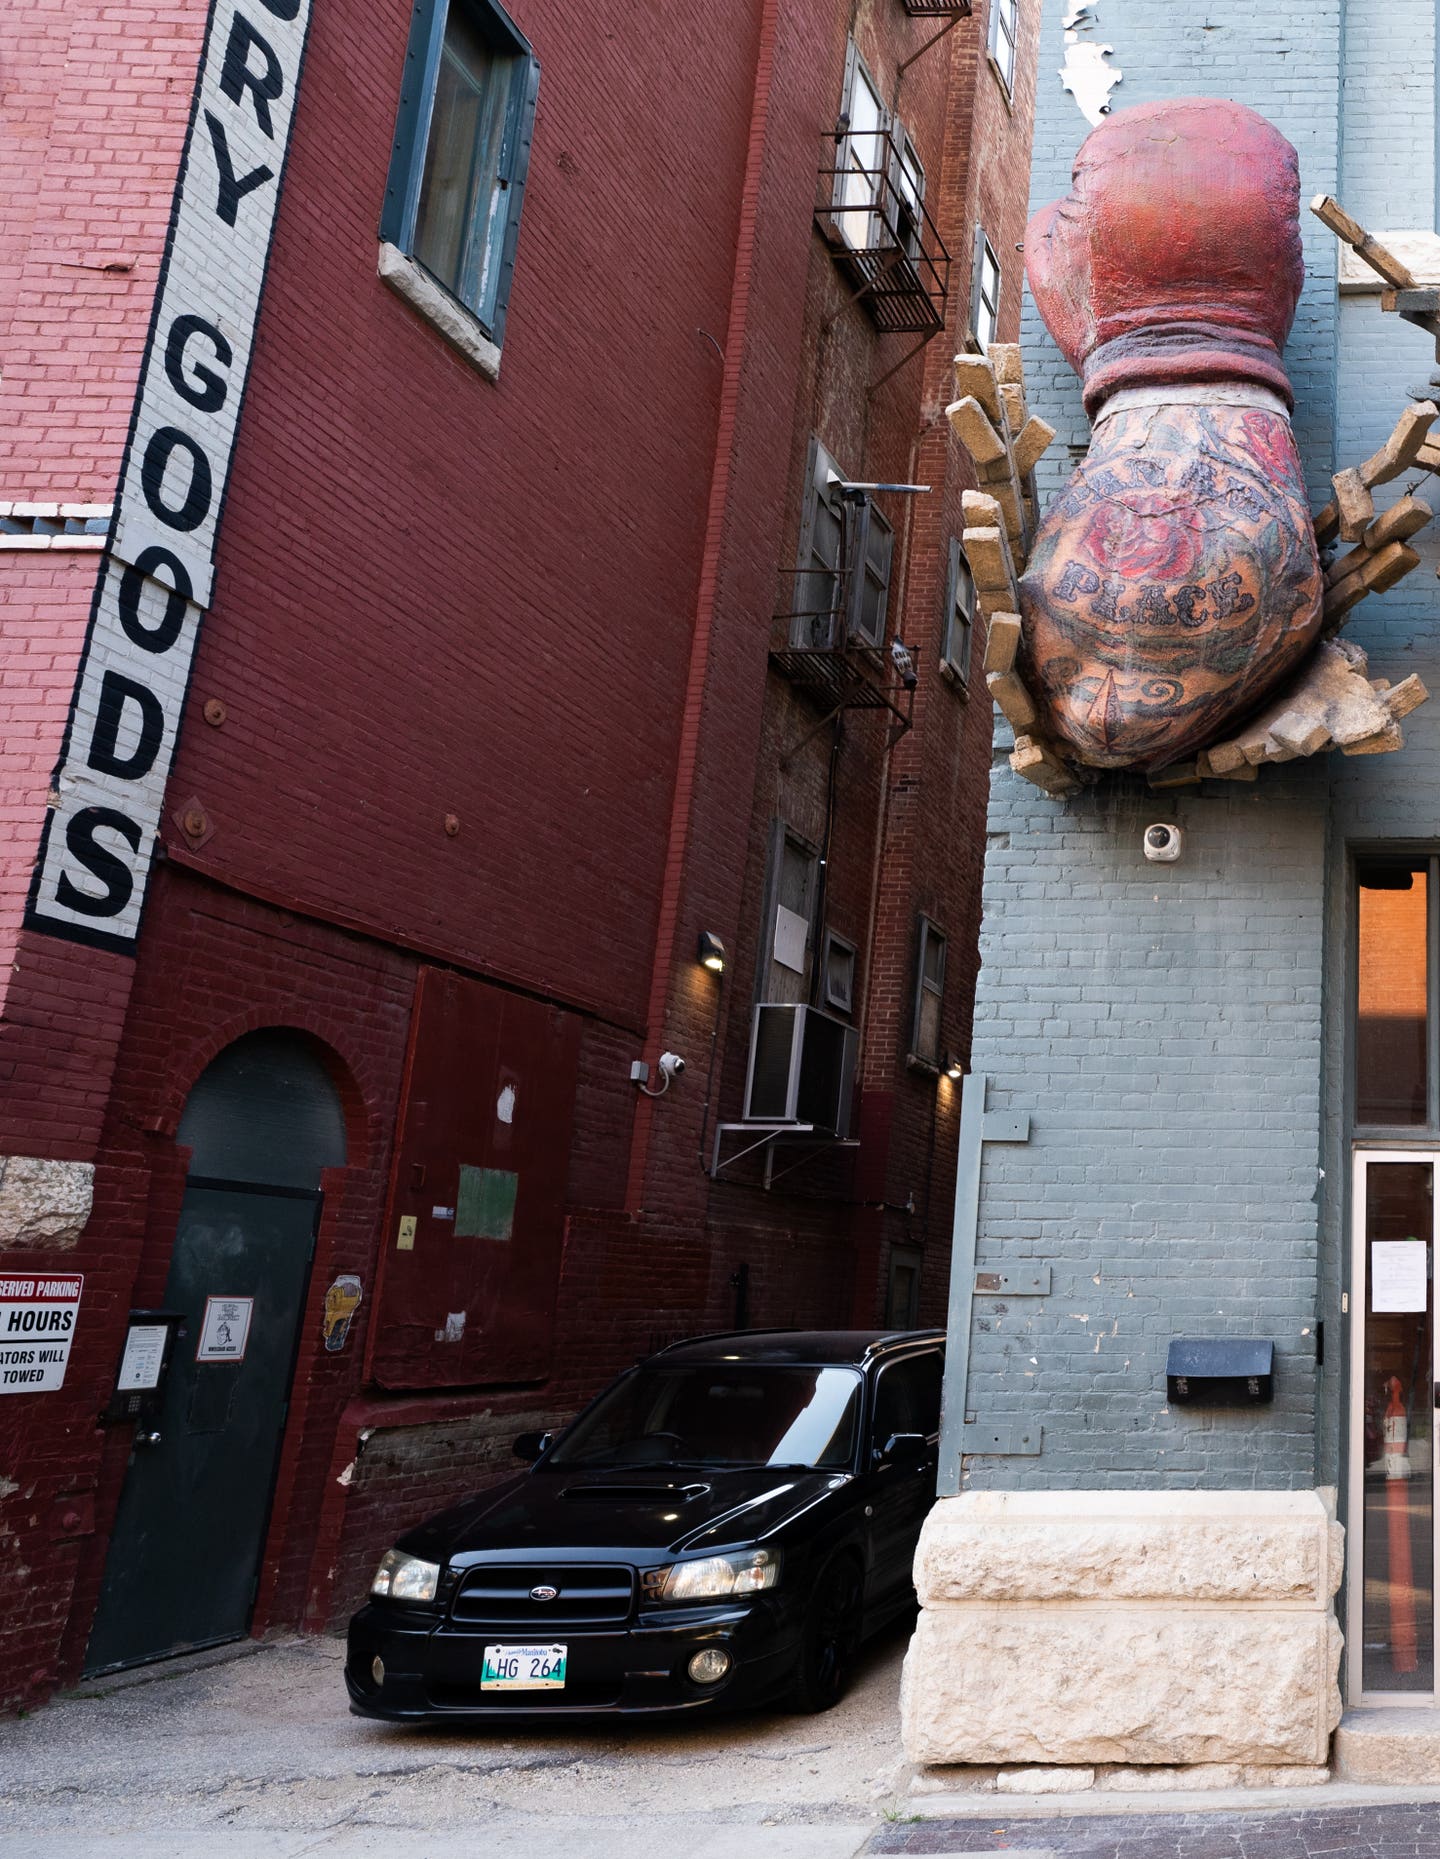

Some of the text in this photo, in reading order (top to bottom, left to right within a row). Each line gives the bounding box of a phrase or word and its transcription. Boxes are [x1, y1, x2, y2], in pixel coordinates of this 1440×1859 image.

[54, 0, 301, 918] RY GOODS
[1052, 560, 1256, 628] PLACE
[36, 1281, 80, 1297] PARKING
[7, 1310, 74, 1332] HOURS
[39, 1350, 65, 1363] WILL
[3, 1369, 45, 1384] TOWED
[485, 1657, 562, 1679] LHG 264
